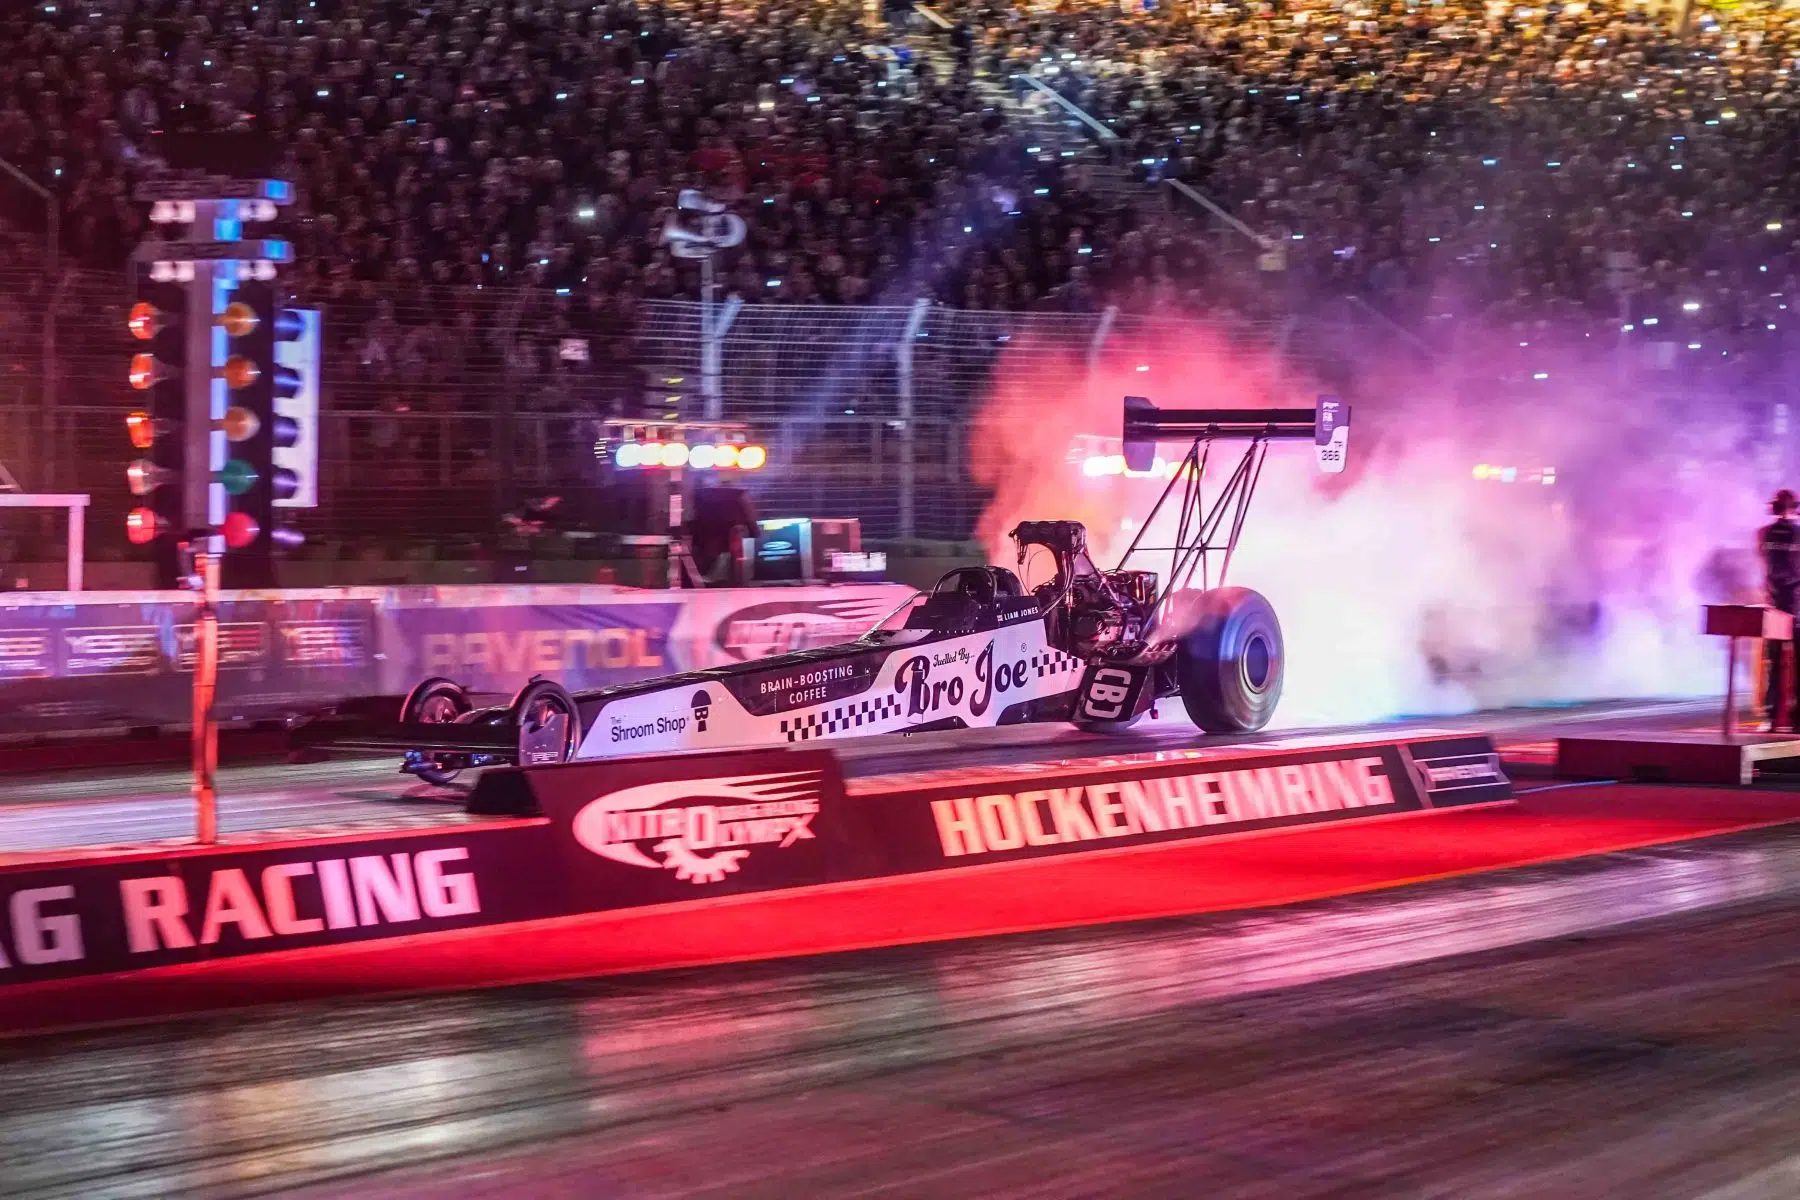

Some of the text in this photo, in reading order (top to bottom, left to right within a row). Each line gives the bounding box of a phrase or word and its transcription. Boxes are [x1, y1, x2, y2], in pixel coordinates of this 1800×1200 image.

[1004, 606, 1039, 621] LIAM JONES
[760, 665, 853, 694] BRAIN-BOOSTING
[894, 638, 1029, 718] Bro Joe
[789, 686, 827, 704] COFFEE
[611, 716, 686, 743] Shroom Shop
[930, 757, 1394, 858] HOCKENHEIMRING
[119, 847, 481, 954] RACING
